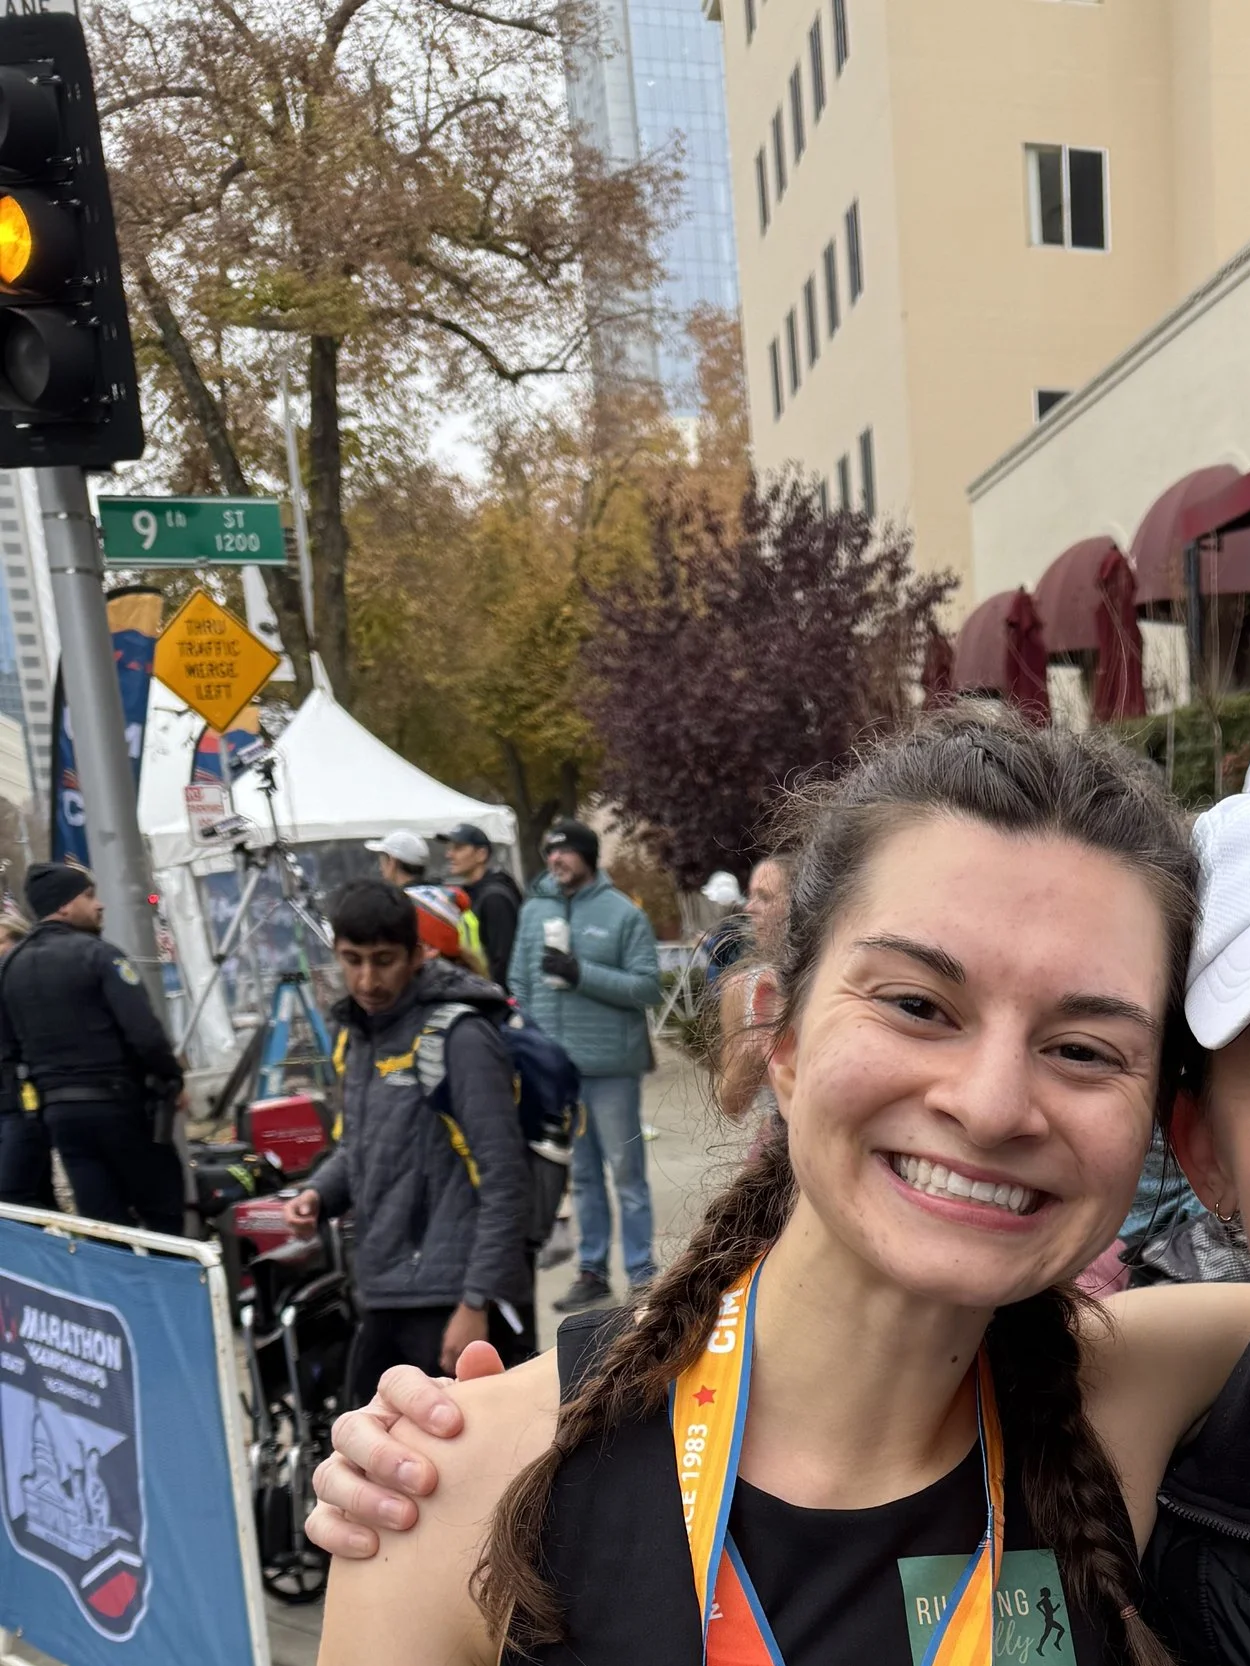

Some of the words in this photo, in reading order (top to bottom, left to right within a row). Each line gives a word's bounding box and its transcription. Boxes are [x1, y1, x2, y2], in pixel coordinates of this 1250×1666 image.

[222, 510, 245, 529] ST
[215, 533, 260, 552] 1200
[185, 619, 226, 636] THRU
[177, 640, 240, 657] TRAFFIC
[184, 662, 238, 679] MERGE
[195, 684, 232, 700] LEFT
[19, 1305, 122, 1371] MARATHON
[681, 1424, 708, 1482] 1983
[707, 1288, 744, 1354] CIM
[916, 1589, 1030, 1625] RUNG
